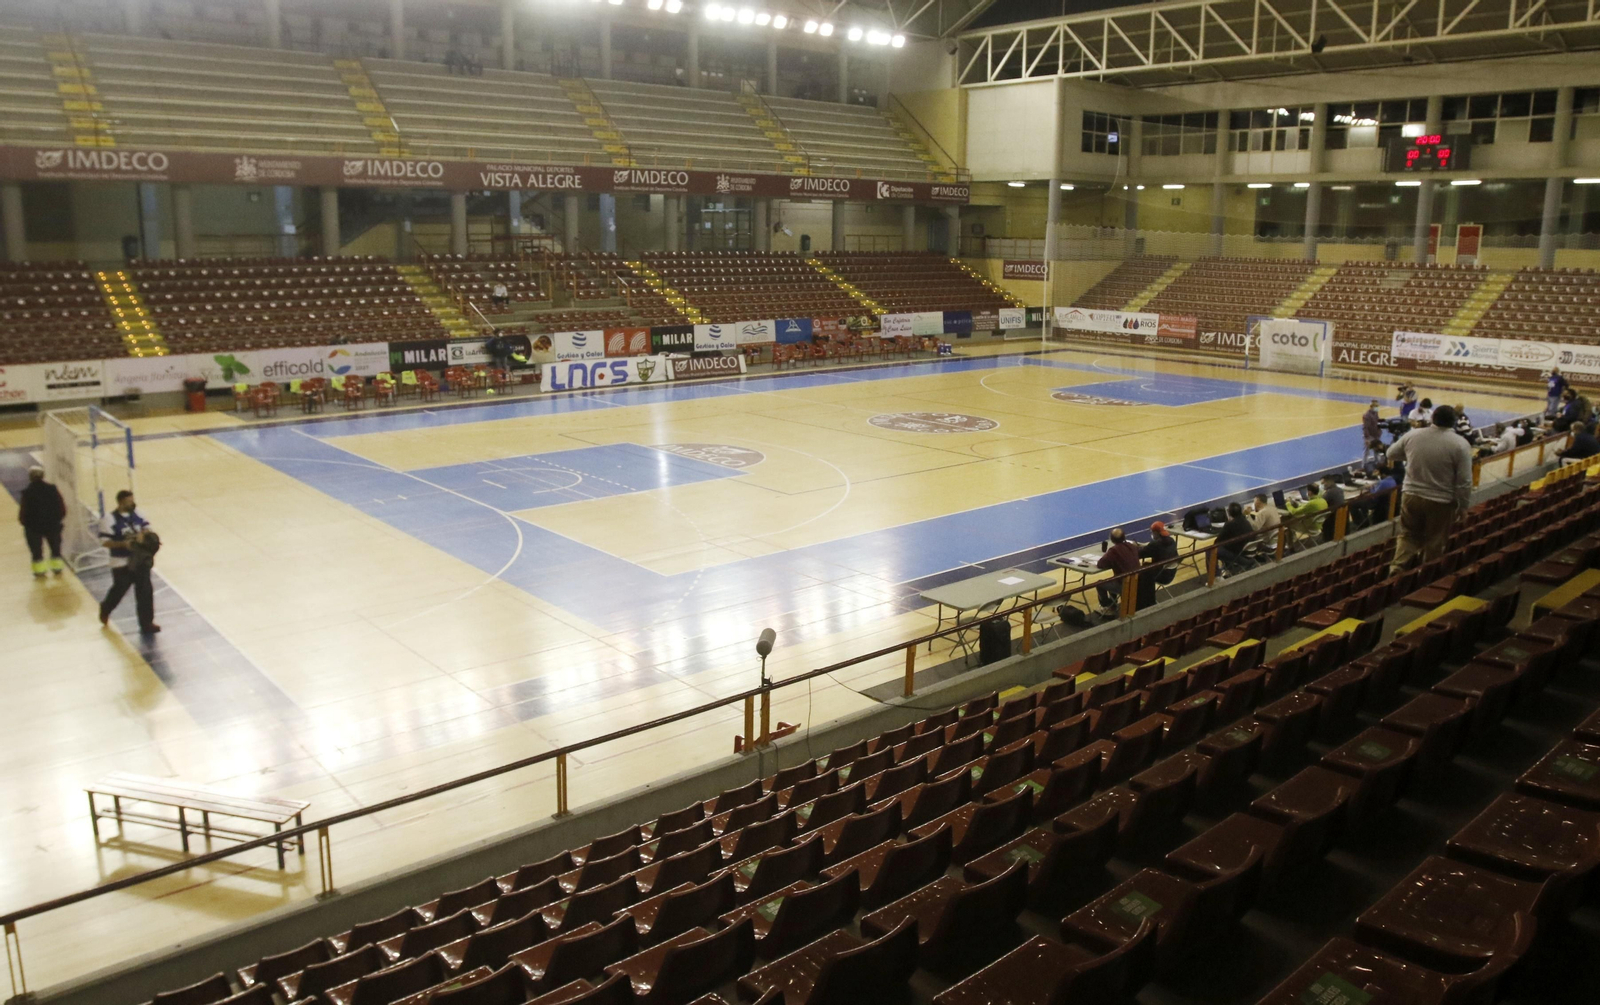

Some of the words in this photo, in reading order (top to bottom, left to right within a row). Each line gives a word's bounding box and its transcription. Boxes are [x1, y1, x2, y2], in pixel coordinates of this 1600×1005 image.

[67, 149, 169, 171] IMDECO
[366, 160, 444, 178] IMDECO
[480, 172, 522, 187] VISTA
[526, 174, 582, 188] ALEGRE
[632, 170, 689, 186] IMDECO
[804, 178, 850, 192] IMDECO
[940, 186, 968, 196] IMDECO
[1014, 264, 1048, 274] IMDECO
[1000, 316, 1022, 324] UNIFIS
[1032, 312, 1050, 322] MILR
[1140, 320, 1156, 328] RIOS
[662, 332, 693, 346] MILAR
[1218, 332, 1260, 348] IMDEC
[1272, 332, 1309, 348] coto
[404, 348, 447, 364] MILAR
[1473, 344, 1497, 354] Sierra
[690, 356, 738, 370] IMDECO
[1338, 349, 1398, 367] ALEGRE
[263, 358, 324, 377] efficold
